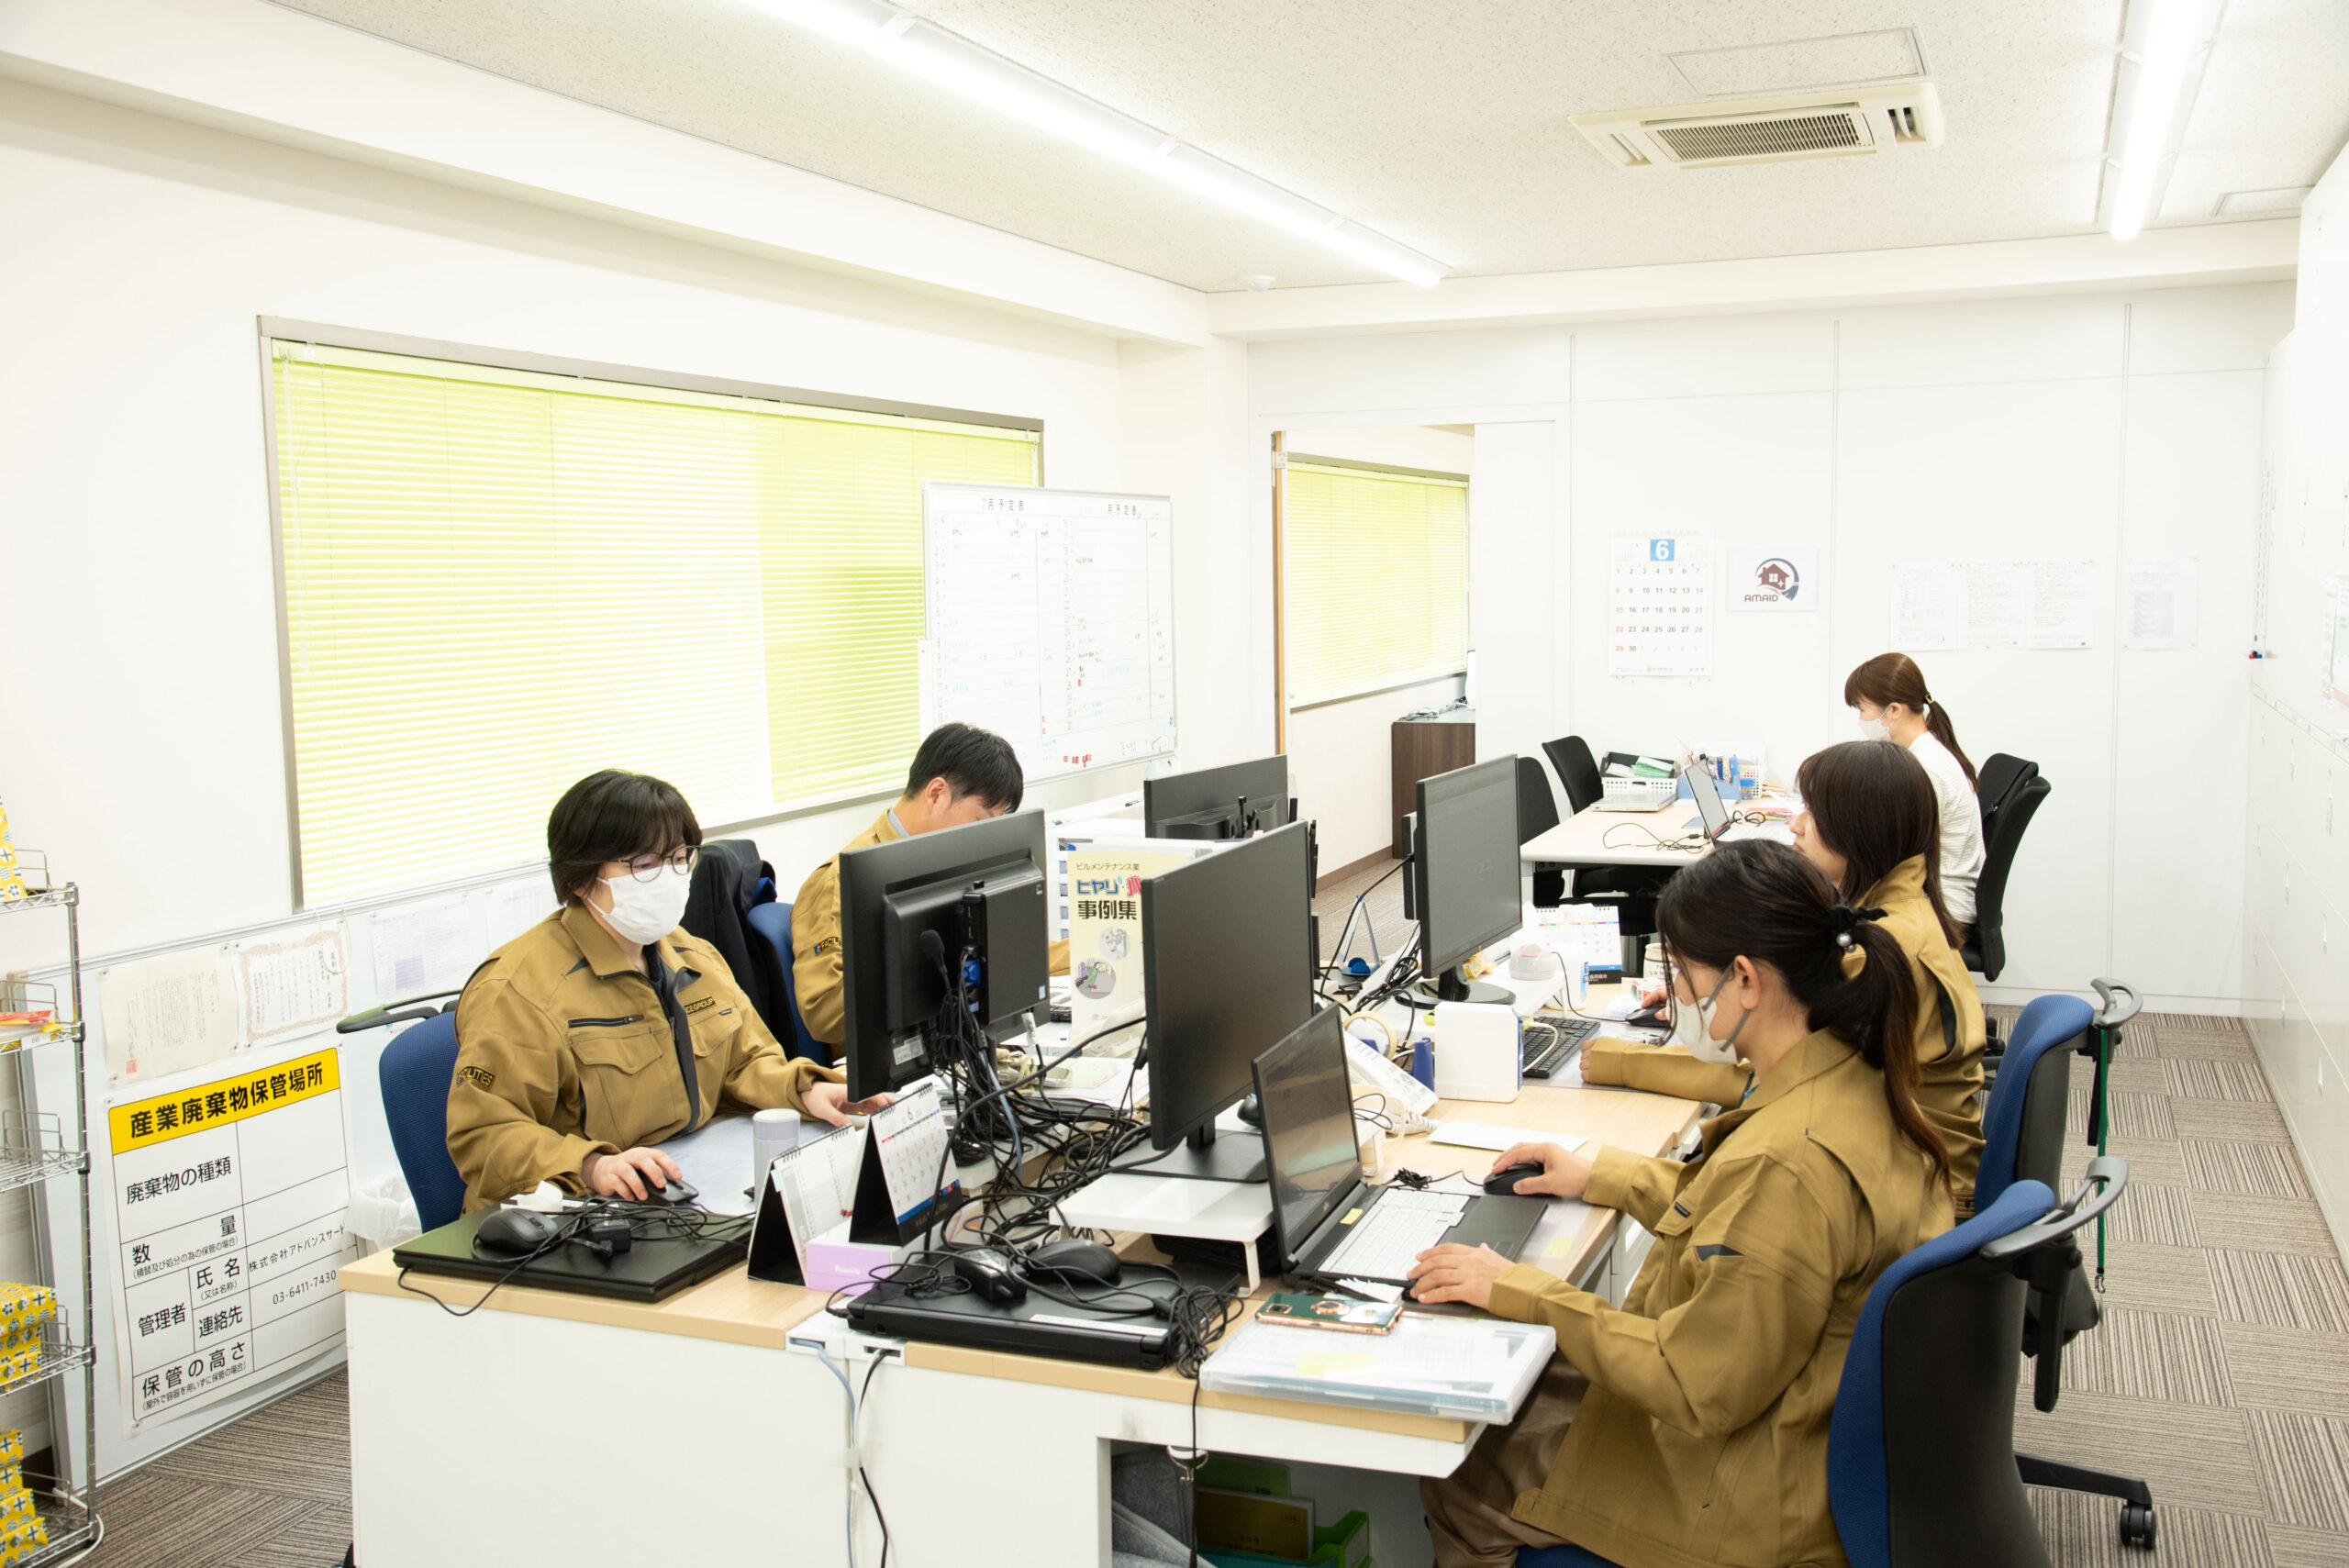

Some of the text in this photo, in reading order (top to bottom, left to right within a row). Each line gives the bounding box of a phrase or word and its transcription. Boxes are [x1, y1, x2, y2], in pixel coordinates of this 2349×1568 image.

[1655, 540, 1669, 560] 6
[1744, 594, 1778, 602] AMAID
[1076, 863, 1140, 871] ビルメンテナンス業
[1078, 900, 1137, 920] 事例集
[130, 1062, 323, 1140] 産業廃棄物保管場所
[127, 1156, 232, 1205] 廃棄物の種類
[799, 1225, 807, 1240] 6
[272, 1269, 337, 1305] 03-6411-7430
[138, 1302, 186, 1338] 管理者
[199, 1305, 243, 1339] 連絡先
[142, 1342, 246, 1399] 保管の高さ
